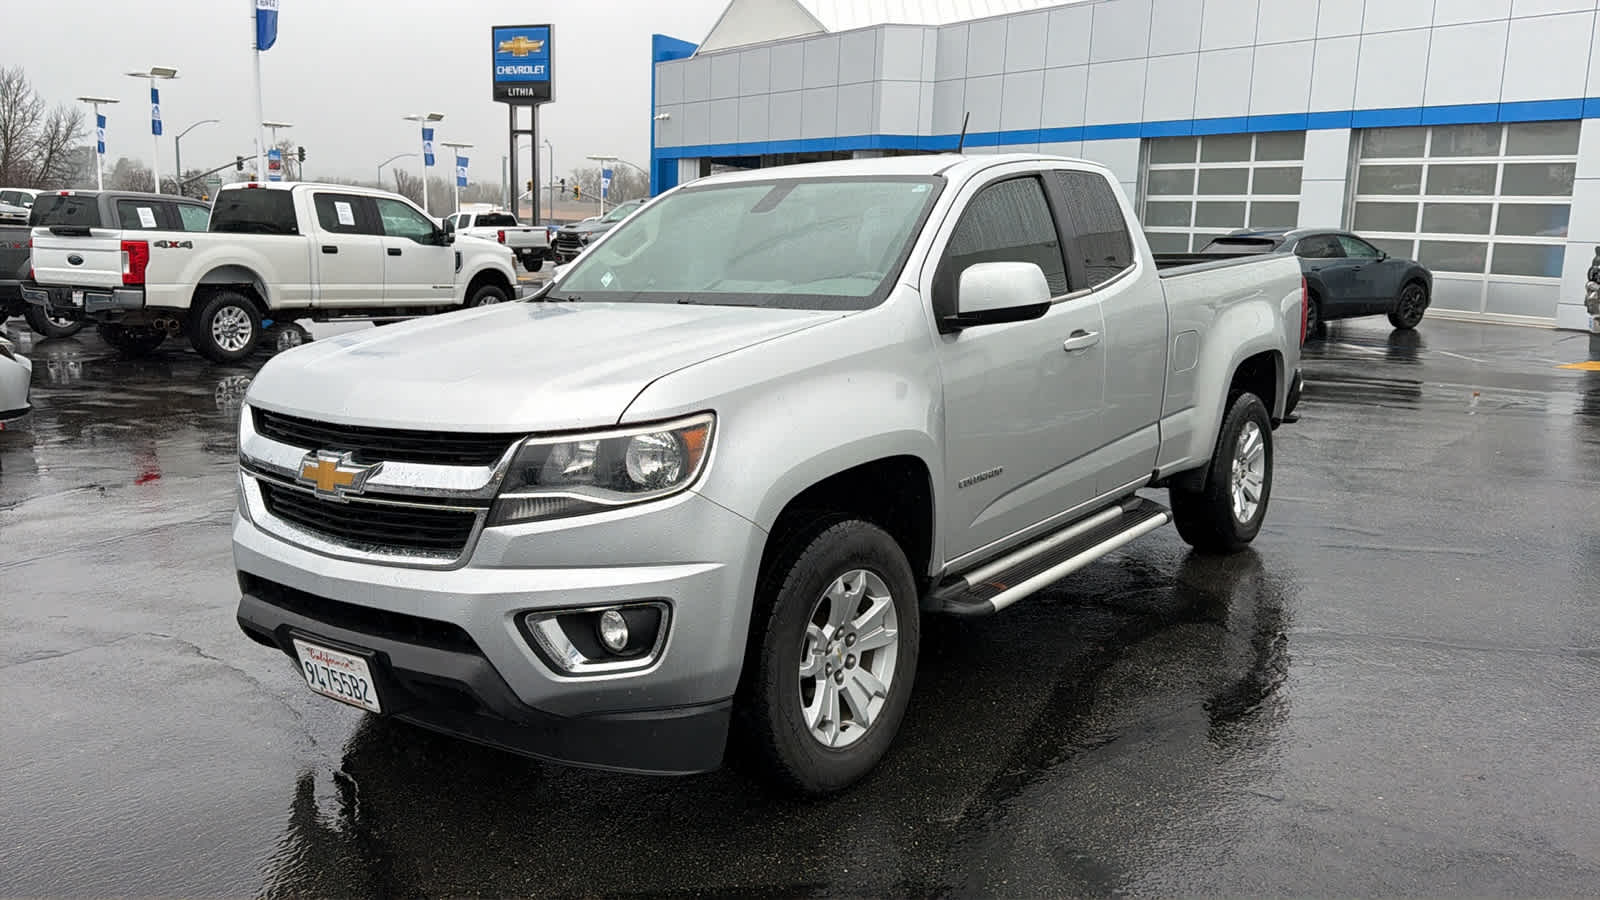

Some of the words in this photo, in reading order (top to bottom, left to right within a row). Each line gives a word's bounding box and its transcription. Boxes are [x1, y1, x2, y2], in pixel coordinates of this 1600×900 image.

[496, 65, 545, 75] CHEVROLET
[507, 87, 534, 97] LITHIA
[958, 466, 1003, 489] COLORADO
[305, 661, 373, 704] 94755B2
